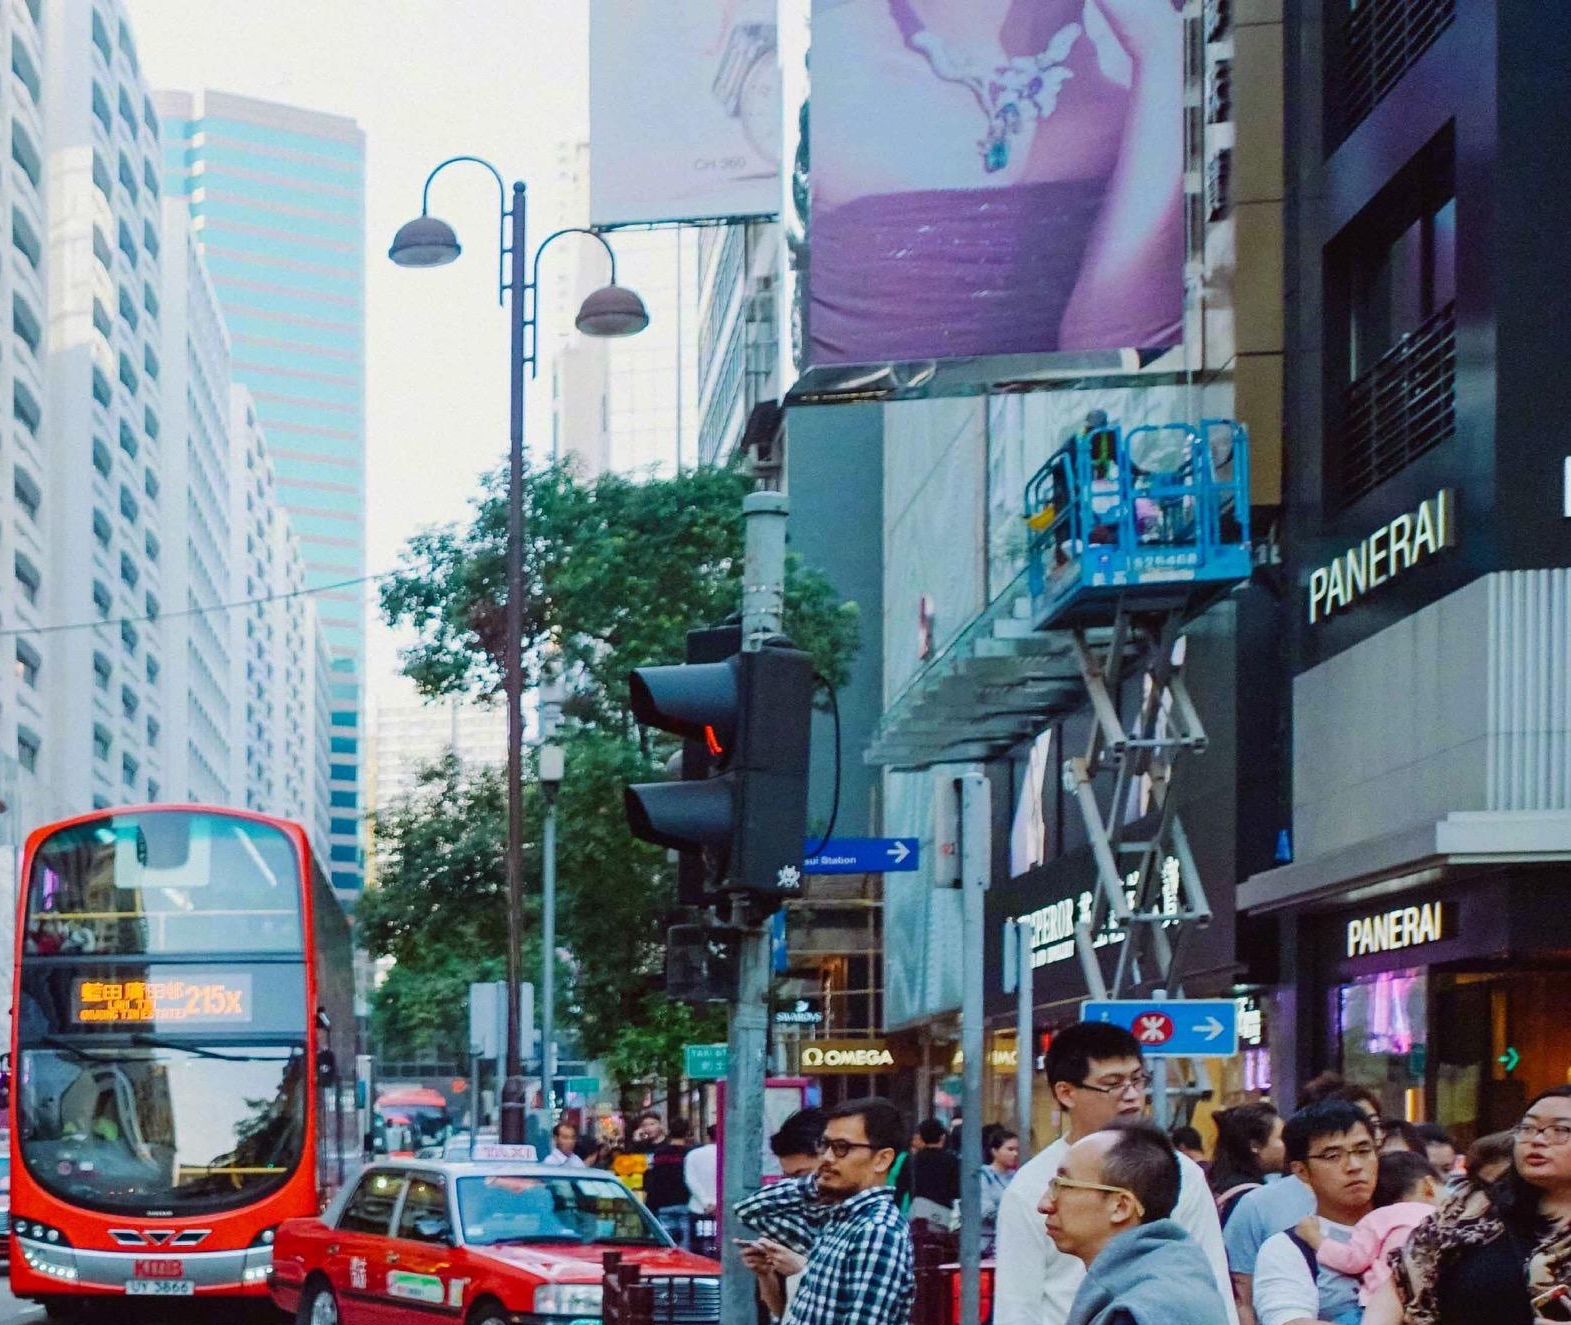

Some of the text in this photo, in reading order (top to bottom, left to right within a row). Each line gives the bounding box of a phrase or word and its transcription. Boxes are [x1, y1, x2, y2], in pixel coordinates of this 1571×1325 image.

[1309, 489, 1446, 625] PANERAI
[804, 855, 857, 866] sui Station
[1347, 900, 1442, 958] PANERAI
[823, 1049, 894, 1067] OMEGA
[134, 1259, 183, 1278] KMB
